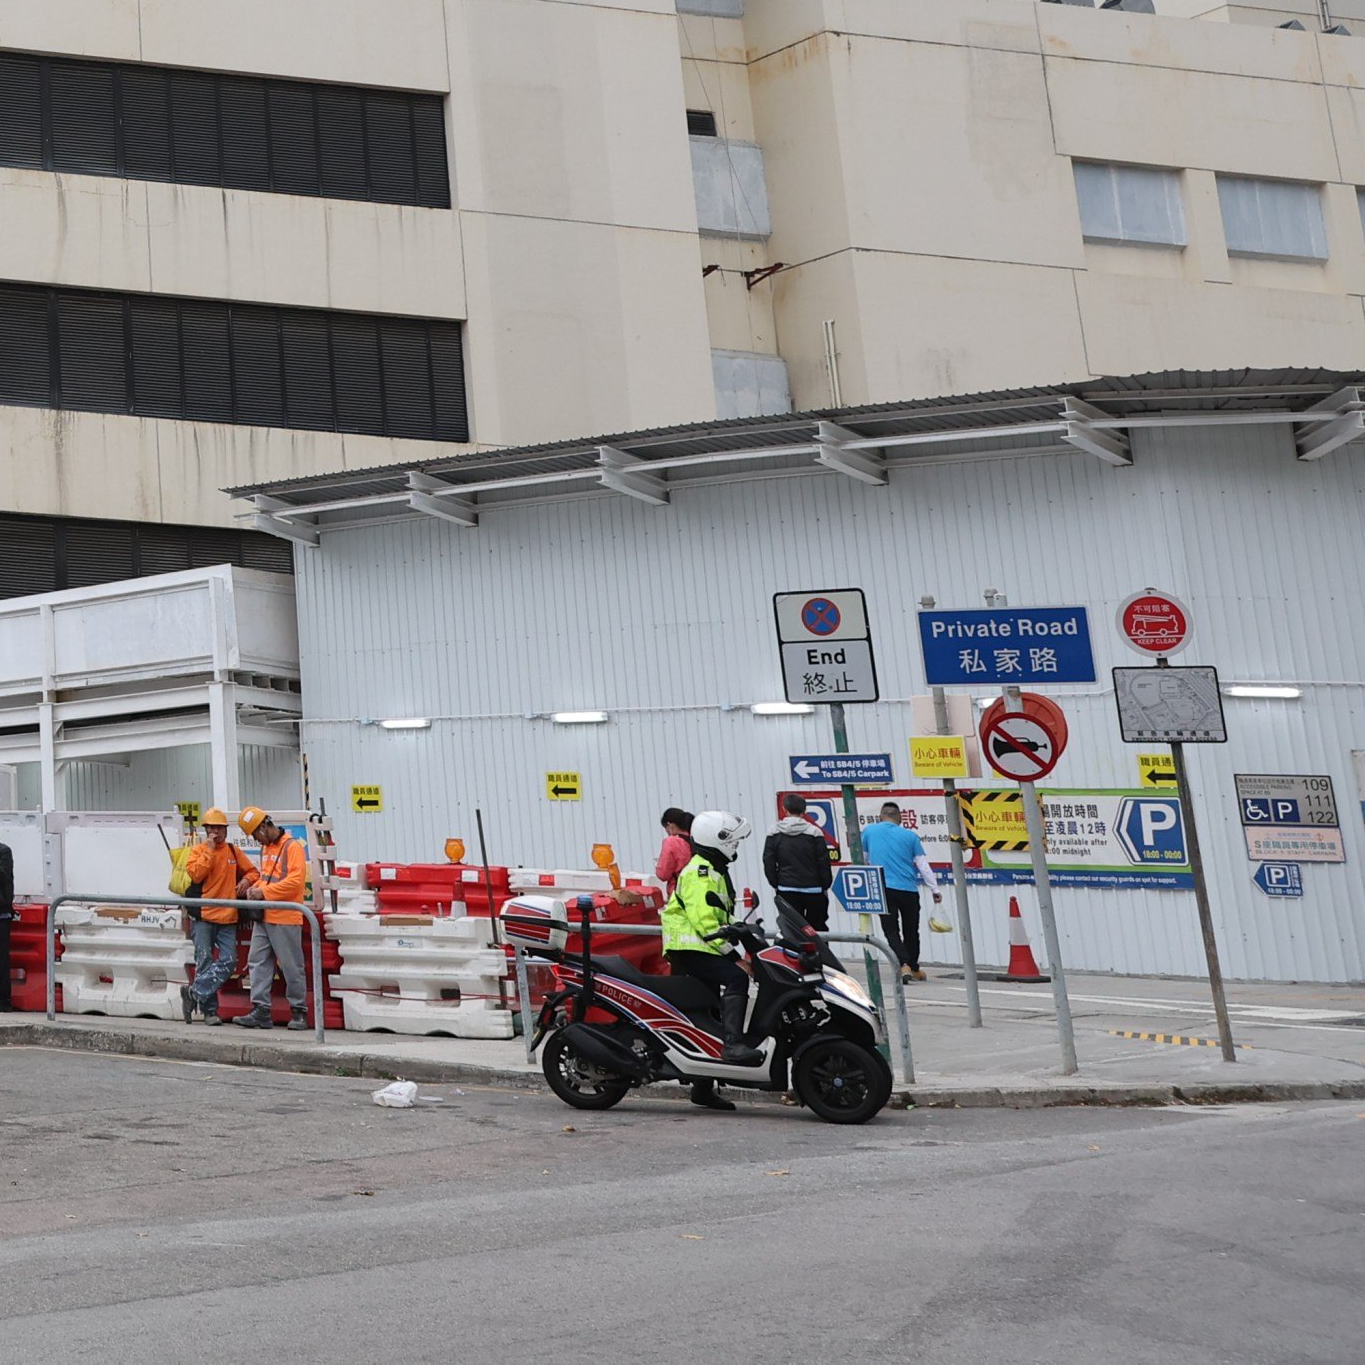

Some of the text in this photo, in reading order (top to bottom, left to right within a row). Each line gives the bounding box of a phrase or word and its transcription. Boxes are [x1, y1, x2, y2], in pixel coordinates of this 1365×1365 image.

[1134, 604, 1170, 612] 不可阻塞
[931, 617, 1078, 638] Private Road
[807, 648, 846, 665] End
[958, 648, 1058, 674] 私家路
[803, 671, 857, 695] 終止
[914, 747, 962, 760] 小心車輛
[836, 760, 861, 768] SB4/5
[862, 759, 886, 768] 停車場
[1140, 757, 1174, 766] 職員通
[832, 770, 857, 778] SB4/5
[857, 770, 890, 778] Carpark
[1301, 778, 1329, 791] 109
[1305, 795, 1331, 807] 111
[975, 810, 1027, 823] 小心車輛
[1277, 802, 1293, 819] P
[1307, 811, 1335, 824] 122
[1140, 803, 1177, 846] P
[1090, 838, 1108, 846] after
[1062, 847, 1091, 856] midnight
[1143, 850, 1160, 859] 18:00
[1270, 867, 1285, 884] P
[847, 874, 863, 896] P
[846, 901, 862, 909] 18:00
[602, 984, 634, 1006] POLICE
